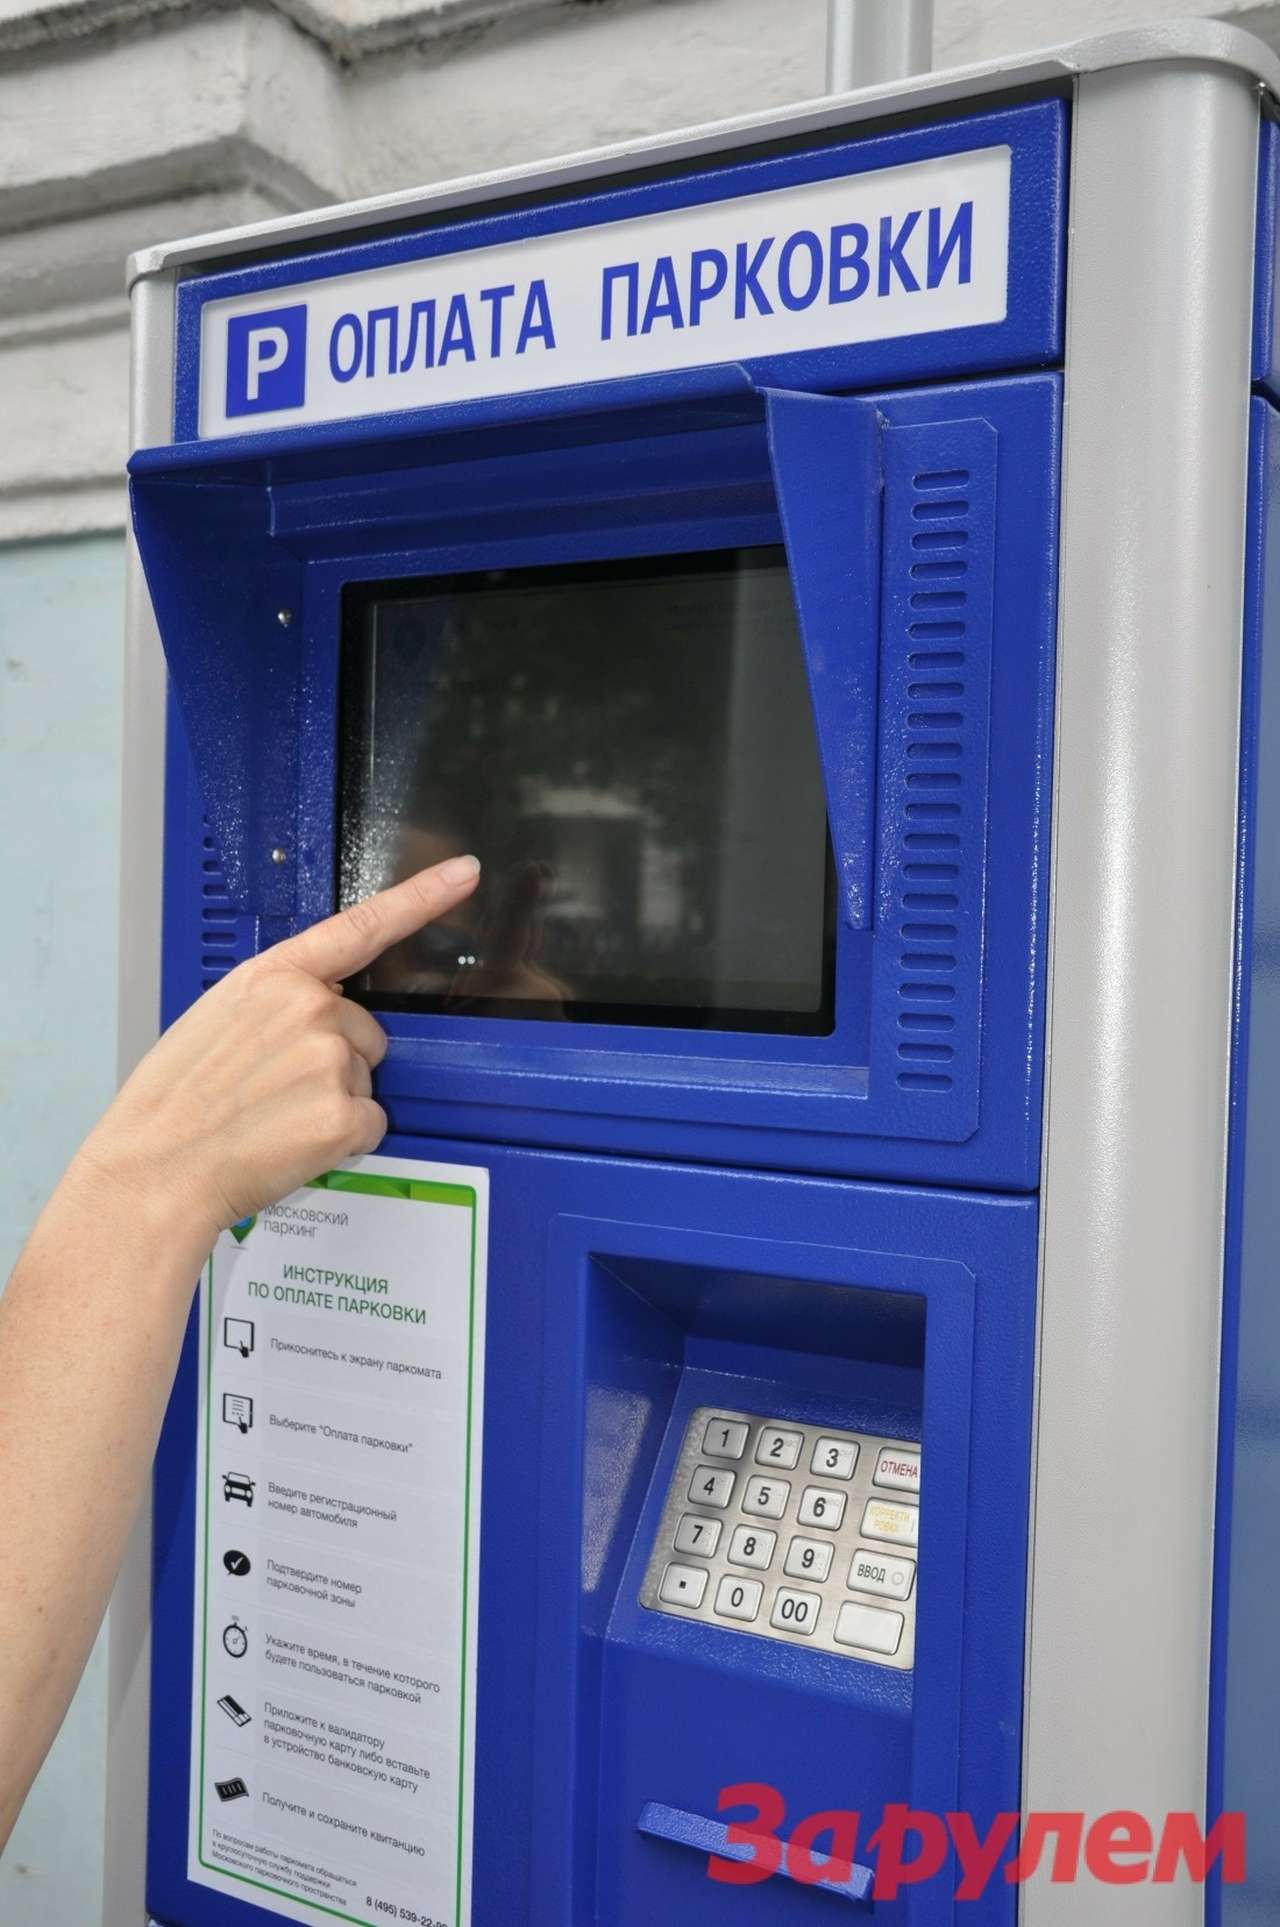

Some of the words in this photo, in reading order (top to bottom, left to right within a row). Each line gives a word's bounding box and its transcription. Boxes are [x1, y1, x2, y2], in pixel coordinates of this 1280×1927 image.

[328, 279, 556, 384] ОПЛАТА
[600, 201, 975, 341] ПАРКОВКИ
[247, 331, 289, 400] P
[264, 1202, 349, 1226] Московский
[264, 1220, 318, 1239] паркинг
[283, 1264, 389, 1295] ИНСТРУКЦИЯ
[248, 1282, 269, 1298] ПО
[274, 1285, 334, 1310] ОПЛАТЕ
[338, 1296, 427, 1325] ПАРКОВКИ
[270, 1337, 339, 1361] Прикоснитесь
[341, 1354, 347, 1363] к
[350, 1355, 385, 1372] экрану
[387, 1359, 442, 1380] паркомата
[269, 1414, 317, 1434] Выберите
[319, 1424, 359, 1444] "Оплата
[361, 1435, 413, 1454] парковки"
[722, 1429, 730, 1448] 1
[770, 1438, 784, 1457] 2
[826, 1448, 839, 1468] 3
[880, 1459, 918, 1478] ОТМЕНА
[703, 1477, 715, 1496] 4
[758, 1486, 771, 1505] 5
[268, 1481, 307, 1501] Введите
[310, 1493, 397, 1521] регистрационный
[268, 1499, 298, 1517] номер
[300, 1506, 358, 1528] автомобиля
[813, 1497, 826, 1518] 6
[693, 1525, 704, 1544] 7
[744, 1536, 756, 1556] 8
[801, 1548, 815, 1568] 9
[267, 1559, 329, 1585] Подтвердите
[331, 1578, 362, 1595] номер
[857, 1563, 886, 1582] ВВОД
[266, 1576, 329, 1601] парковочной
[331, 1592, 356, 1608] зоны
[731, 1587, 744, 1607] 0
[782, 1598, 808, 1622] 00
[265, 1633, 305, 1655] Укажите
[308, 1647, 341, 1665] время,
[343, 1657, 349, 1666] в
[351, 1660, 391, 1680] течение
[393, 1671, 441, 1693] которого
[265, 1649, 297, 1669] будете
[299, 1660, 366, 1689] пользоваться
[367, 1678, 422, 1704] парковкой
[264, 1701, 318, 1728] Приложите
[320, 1720, 326, 1730] к
[328, 1722, 385, 1750] валидатору
[263, 1719, 327, 1747] парковочную
[329, 1738, 357, 1758] карту
[359, 1747, 384, 1765] либо
[386, 1758, 431, 1780] вставьте
[264, 1735, 270, 1745] в
[271, 1738, 326, 1764] устройство
[328, 1754, 387, 1782] банковскую
[390, 1773, 419, 1793] карту
[262, 1791, 307, 1818] Получите
[309, 1809, 315, 1819] и
[317, 1811, 368, 1837] сохраните
[370, 1826, 426, 1857] квитанцию
[366, 1896, 372, 1907] 8
[374, 1900, 397, 1918] (495)
